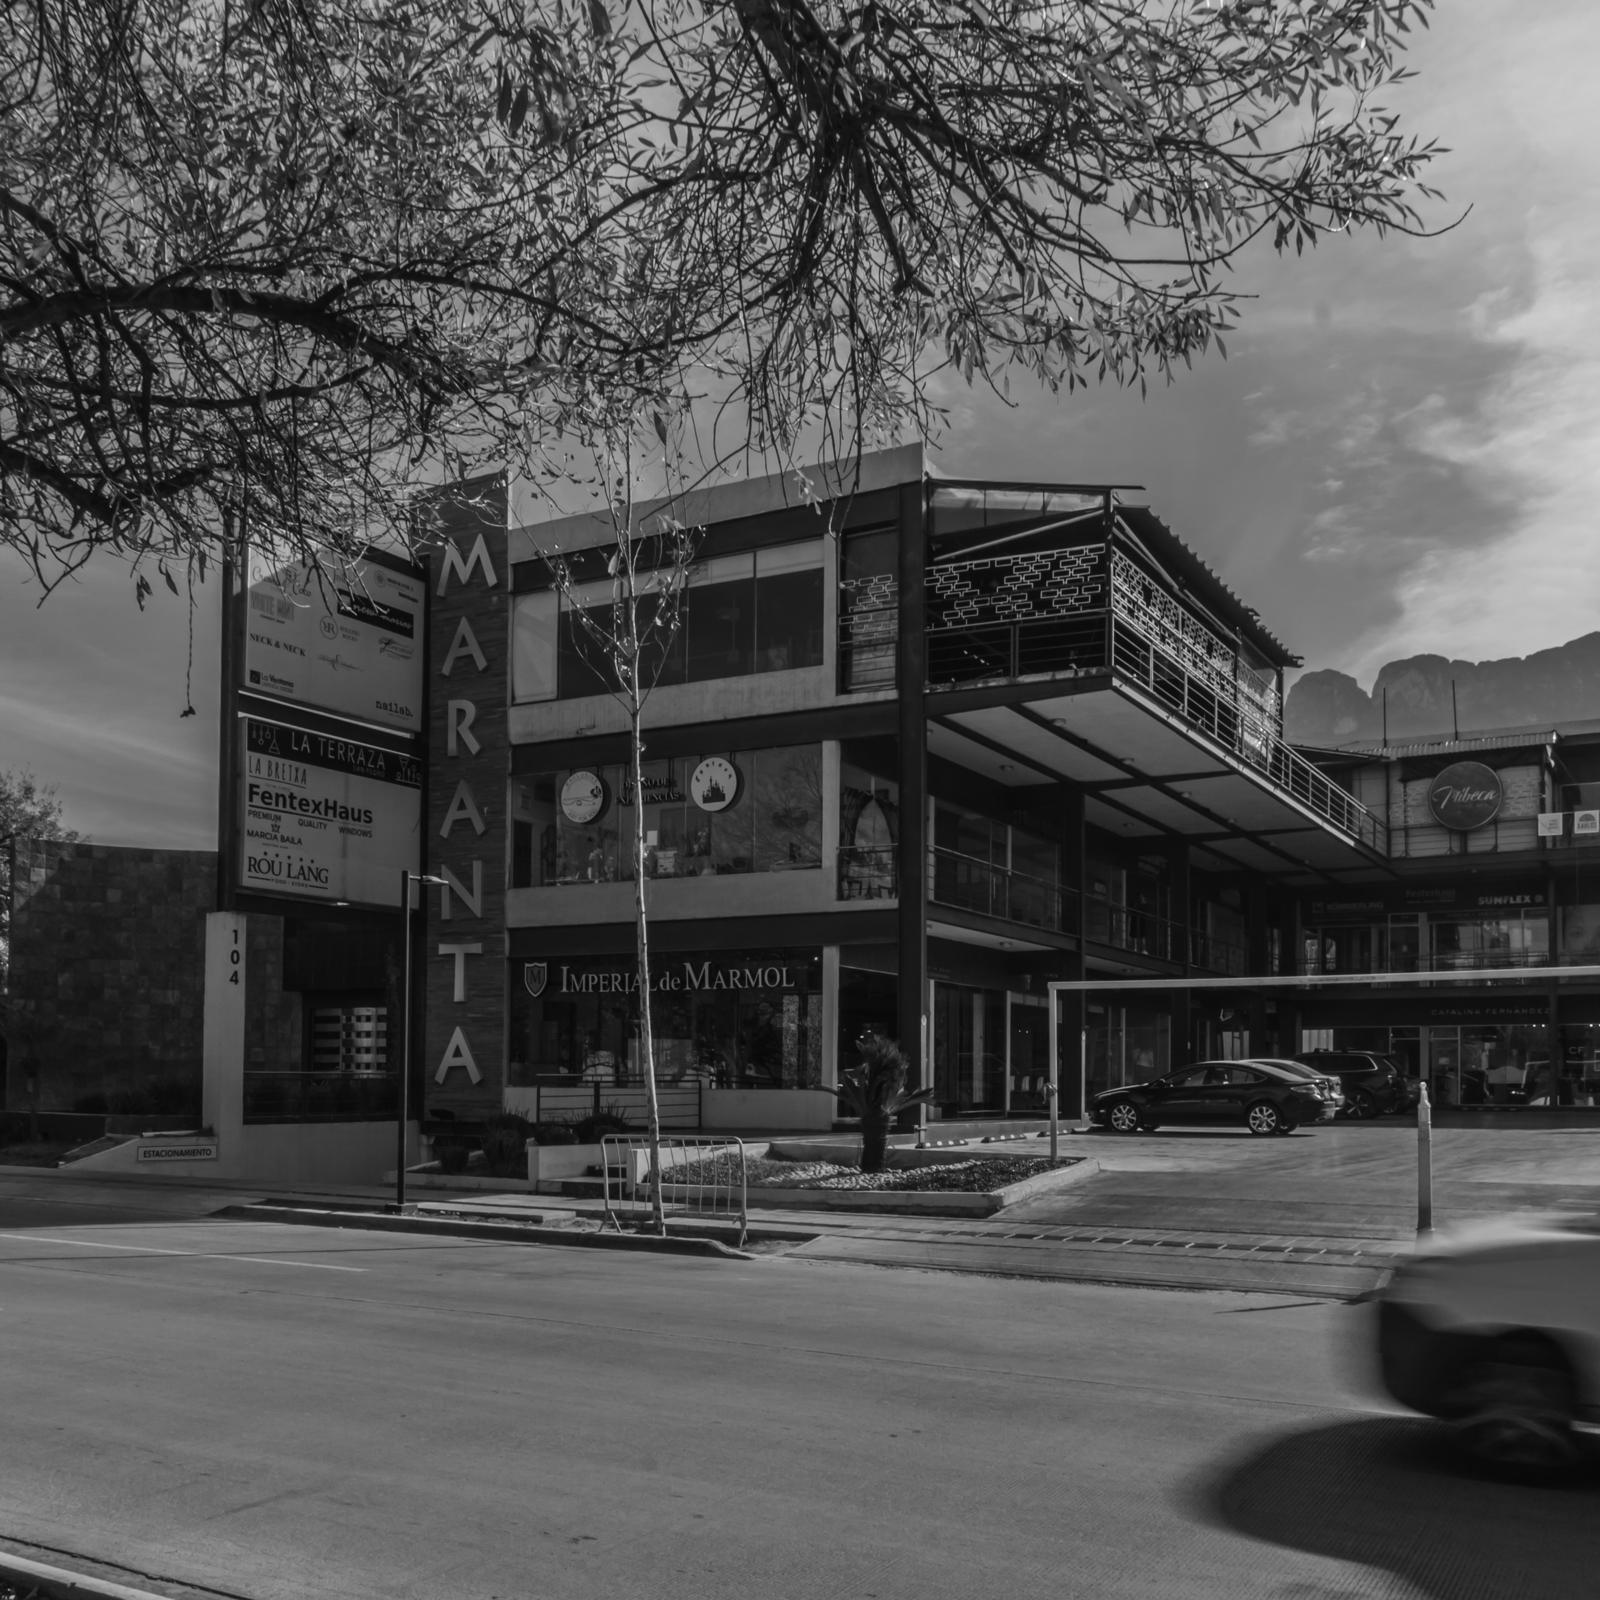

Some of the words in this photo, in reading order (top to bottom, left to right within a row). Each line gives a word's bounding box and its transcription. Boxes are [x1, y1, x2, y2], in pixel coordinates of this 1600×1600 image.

[250, 633, 273, 647] NECK
[274, 641, 281, 649] &
[283, 642, 306, 657] NECK
[249, 755, 261, 775] LA
[292, 731, 311, 754] LA
[318, 737, 386, 770] TERRAZA
[248, 783, 373, 824] FentexHaus
[436, 533, 499, 1085] MARANTA
[247, 829, 278, 841] MARCIA
[248, 809, 281, 822] PREMIUM
[298, 818, 328, 830] QUALITY
[338, 827, 373, 838] WINDOWS
[230, 929, 240, 985] 104
[659, 974, 680, 991] de
[683, 961, 796, 991] MARMOL
[143, 1148, 212, 1158] ESTACIONAMIENTO
